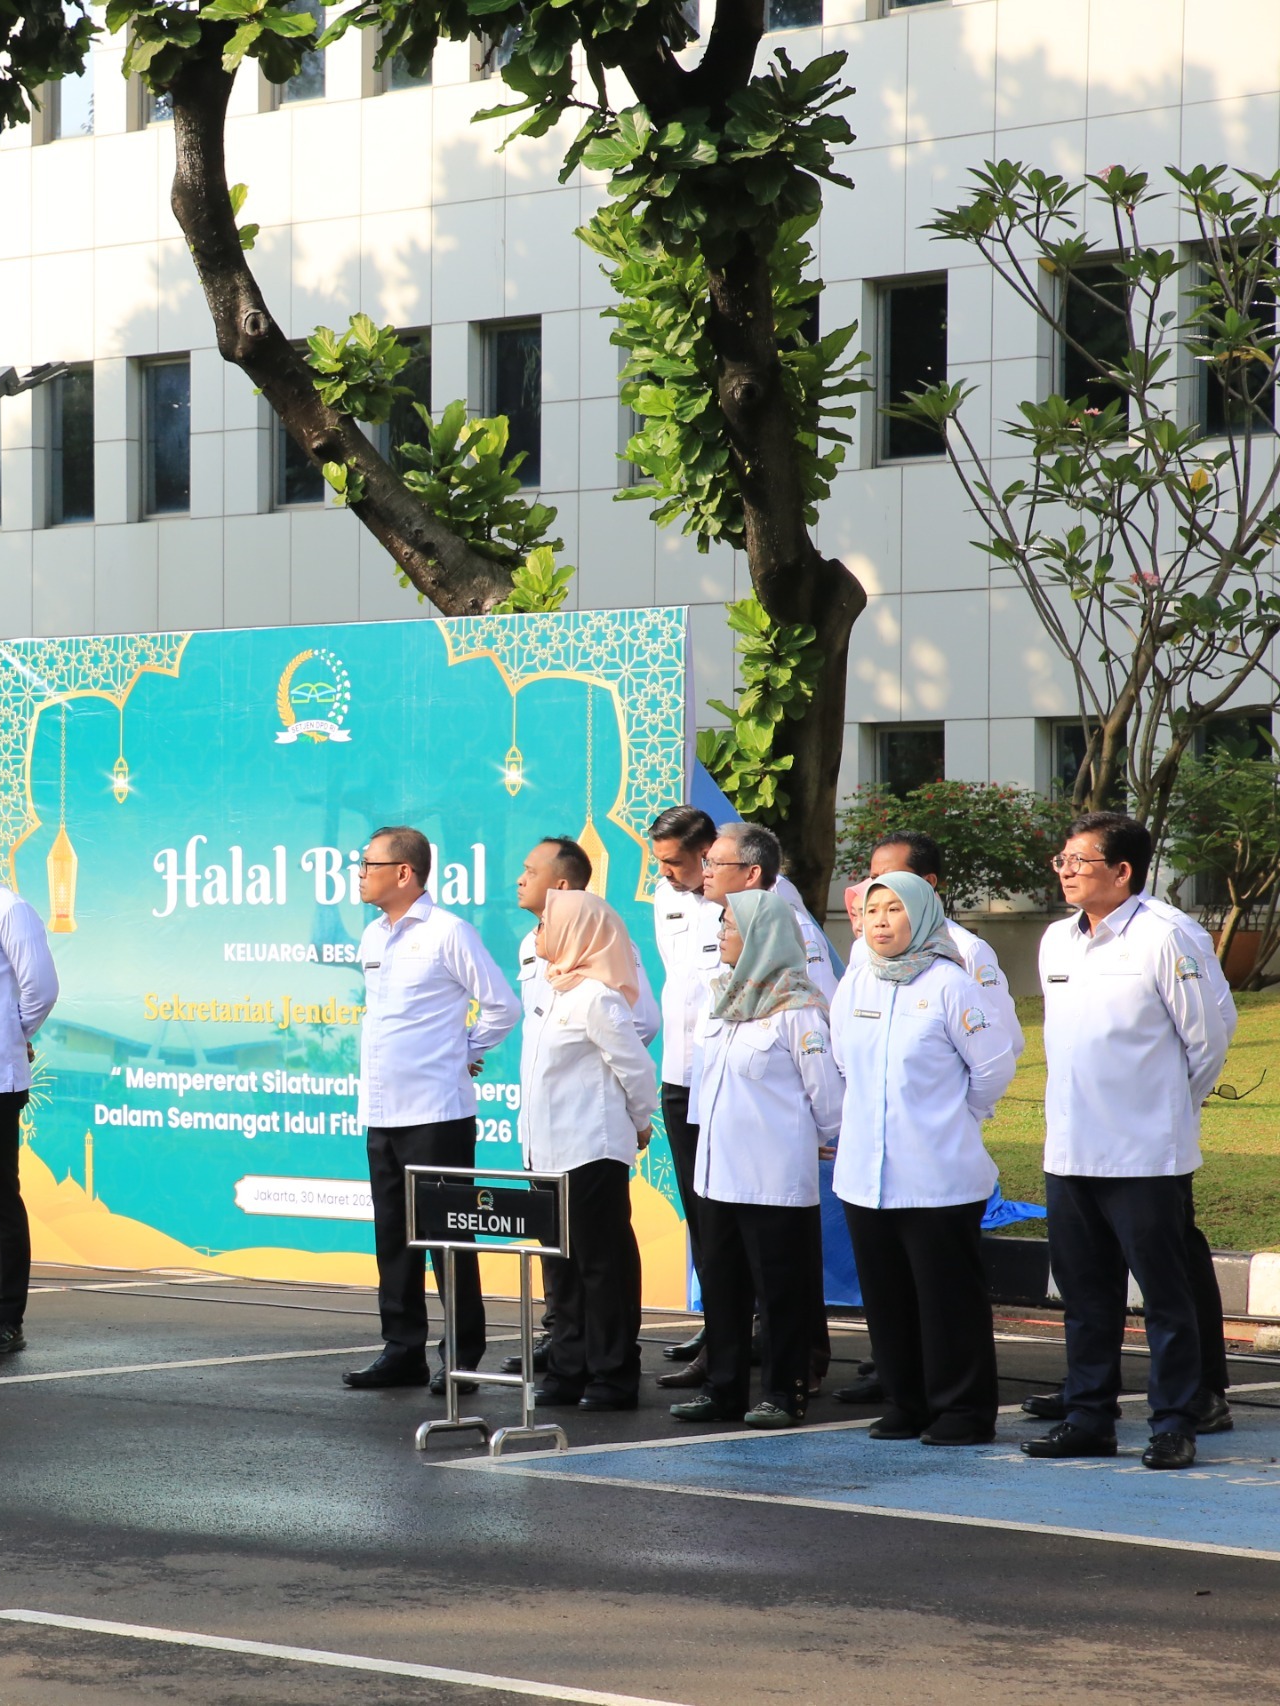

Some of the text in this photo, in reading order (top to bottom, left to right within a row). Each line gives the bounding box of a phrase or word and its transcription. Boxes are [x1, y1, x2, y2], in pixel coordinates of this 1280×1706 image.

[152, 834, 486, 918] Halal Bilal
[224, 943, 319, 963] KELUARGA
[144, 992, 479, 1030] Sekretariat Jender R
[126, 1067, 258, 1097] Mempererat
[473, 1082, 521, 1110] nerg
[95, 1104, 164, 1128] Dalam
[168, 1106, 280, 1139] Semangat
[285, 1111, 325, 1135] Idul
[475, 1118, 512, 1143] 026
[254, 1189, 372, 1207] Jakarta, 30 Maret 202
[447, 1212, 525, 1234] ESELON II
